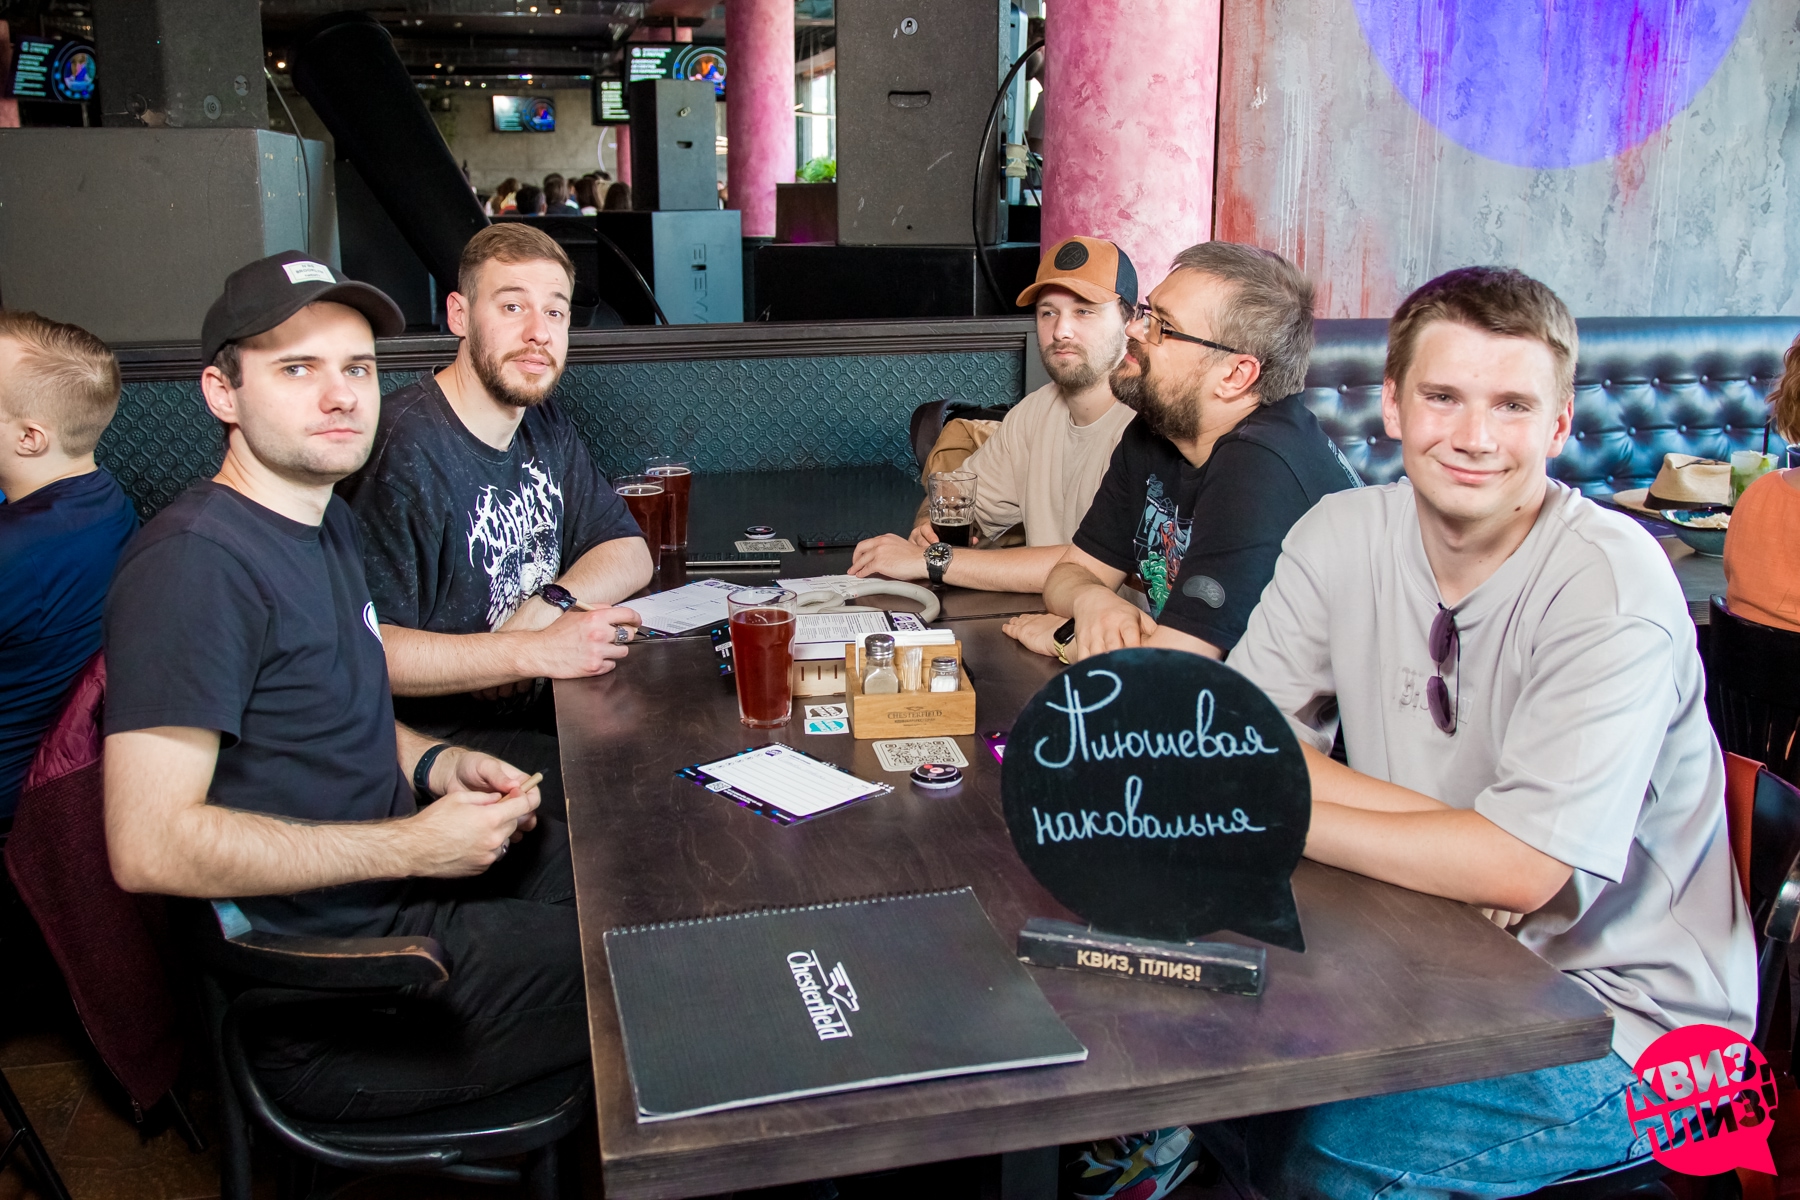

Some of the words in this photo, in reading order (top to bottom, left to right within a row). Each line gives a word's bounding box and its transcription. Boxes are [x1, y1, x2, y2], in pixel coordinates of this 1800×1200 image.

[1034, 670, 1279, 768] Плюшевая
[1032, 775, 1266, 845] наковальня
[786, 951, 849, 1040] Chesterfield
[1077, 949, 1135, 975] КВИЗ,
[1139, 958, 1202, 982] ПЛИЗ!
